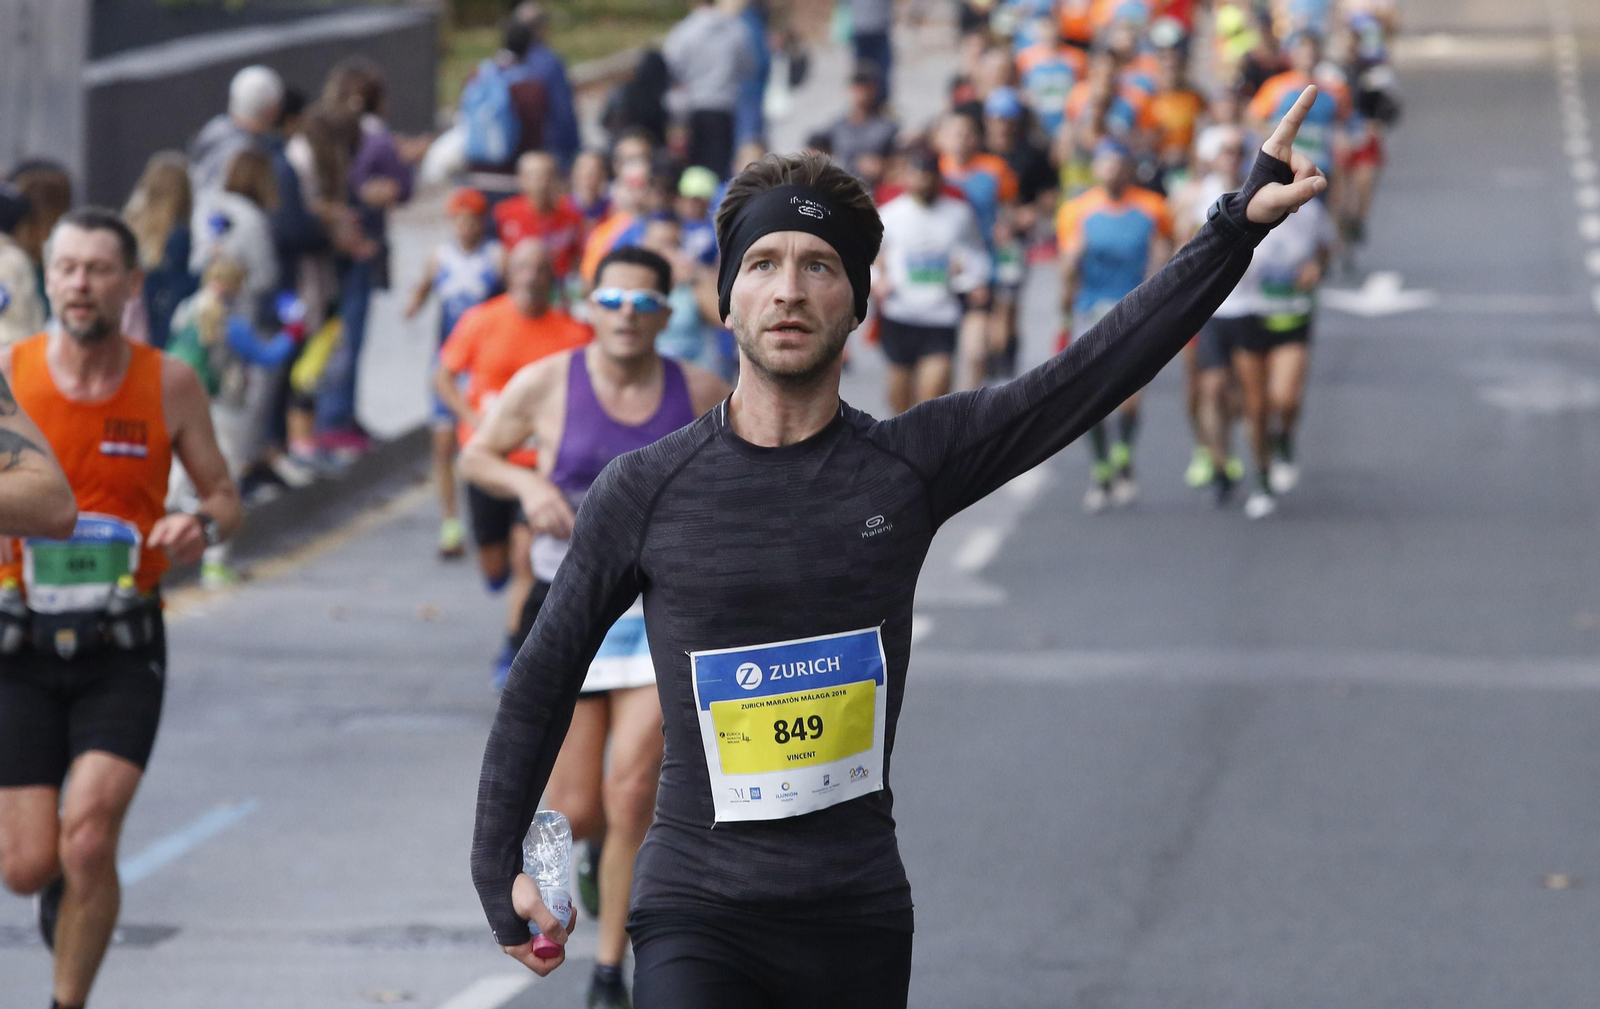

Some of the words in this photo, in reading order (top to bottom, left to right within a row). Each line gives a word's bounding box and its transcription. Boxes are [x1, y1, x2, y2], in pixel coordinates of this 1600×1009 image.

[769, 656, 840, 681] ZURICH
[741, 701, 765, 710] ZURICH
[766, 696, 799, 707] MARATÓN
[800, 692, 830, 702] MÁLAGA
[774, 714, 824, 744] 849
[786, 751, 816, 761] VINCENT
